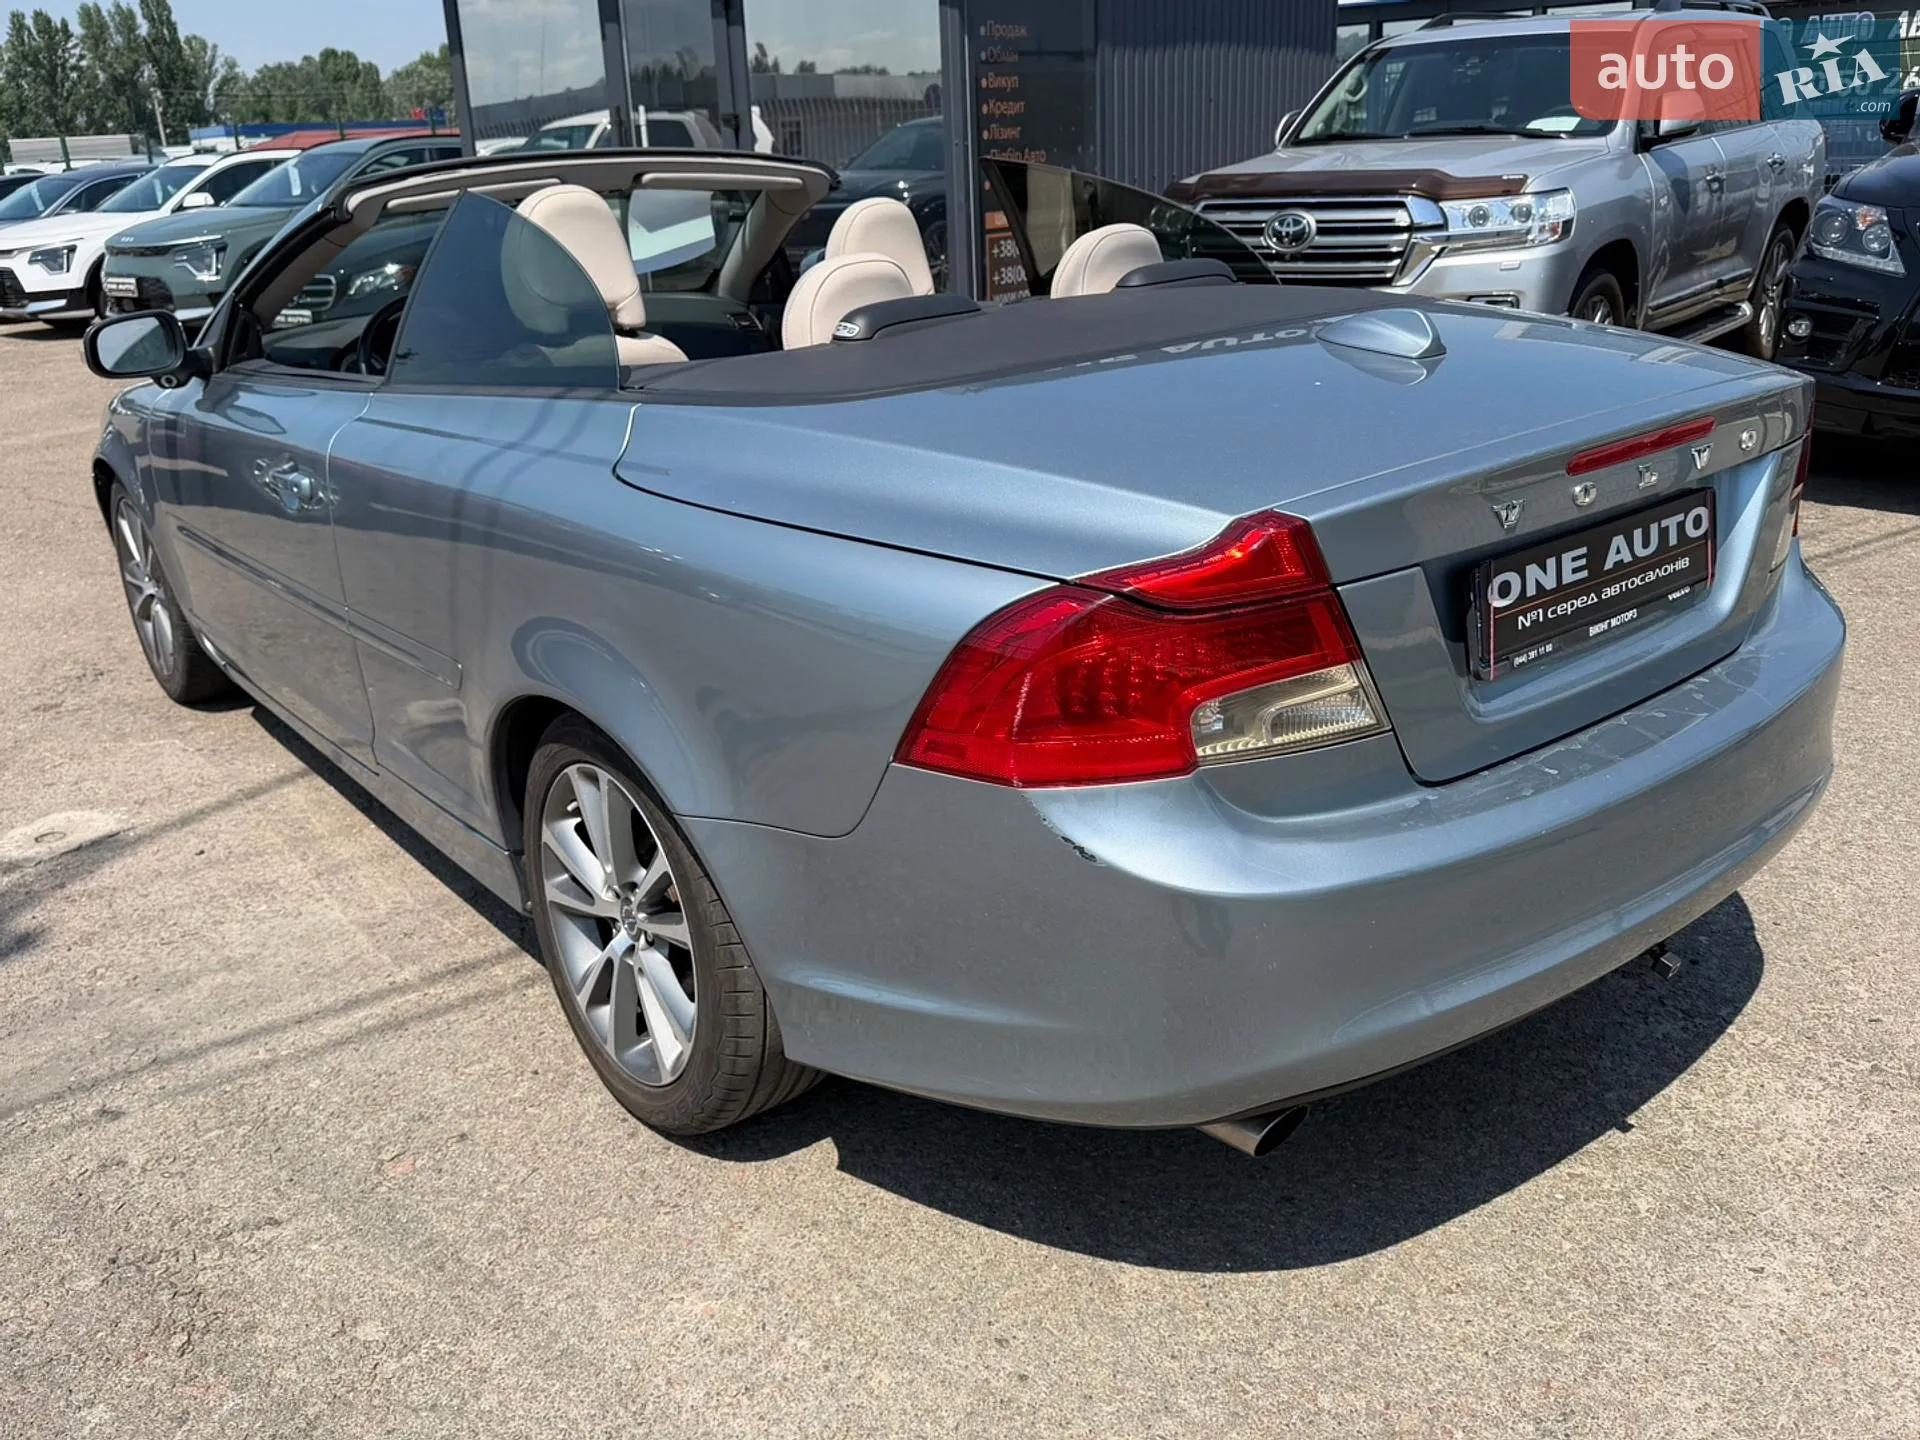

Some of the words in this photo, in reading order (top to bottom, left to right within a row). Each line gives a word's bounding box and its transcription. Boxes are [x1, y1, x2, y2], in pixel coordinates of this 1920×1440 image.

[986, 20, 1028, 40] Продаж
[988, 72, 1019, 92] Викуп
[989, 99, 1025, 118] Кредит
[989, 124, 1021, 140] Лізинг
[1491, 428, 1758, 529] VOLVO
[1487, 546, 1590, 608] ONE
[1603, 506, 1710, 571] AUTO
[1517, 609, 1543, 631] №1
[1547, 592, 1599, 618] серед
[1601, 557, 1690, 600] автосалонів
